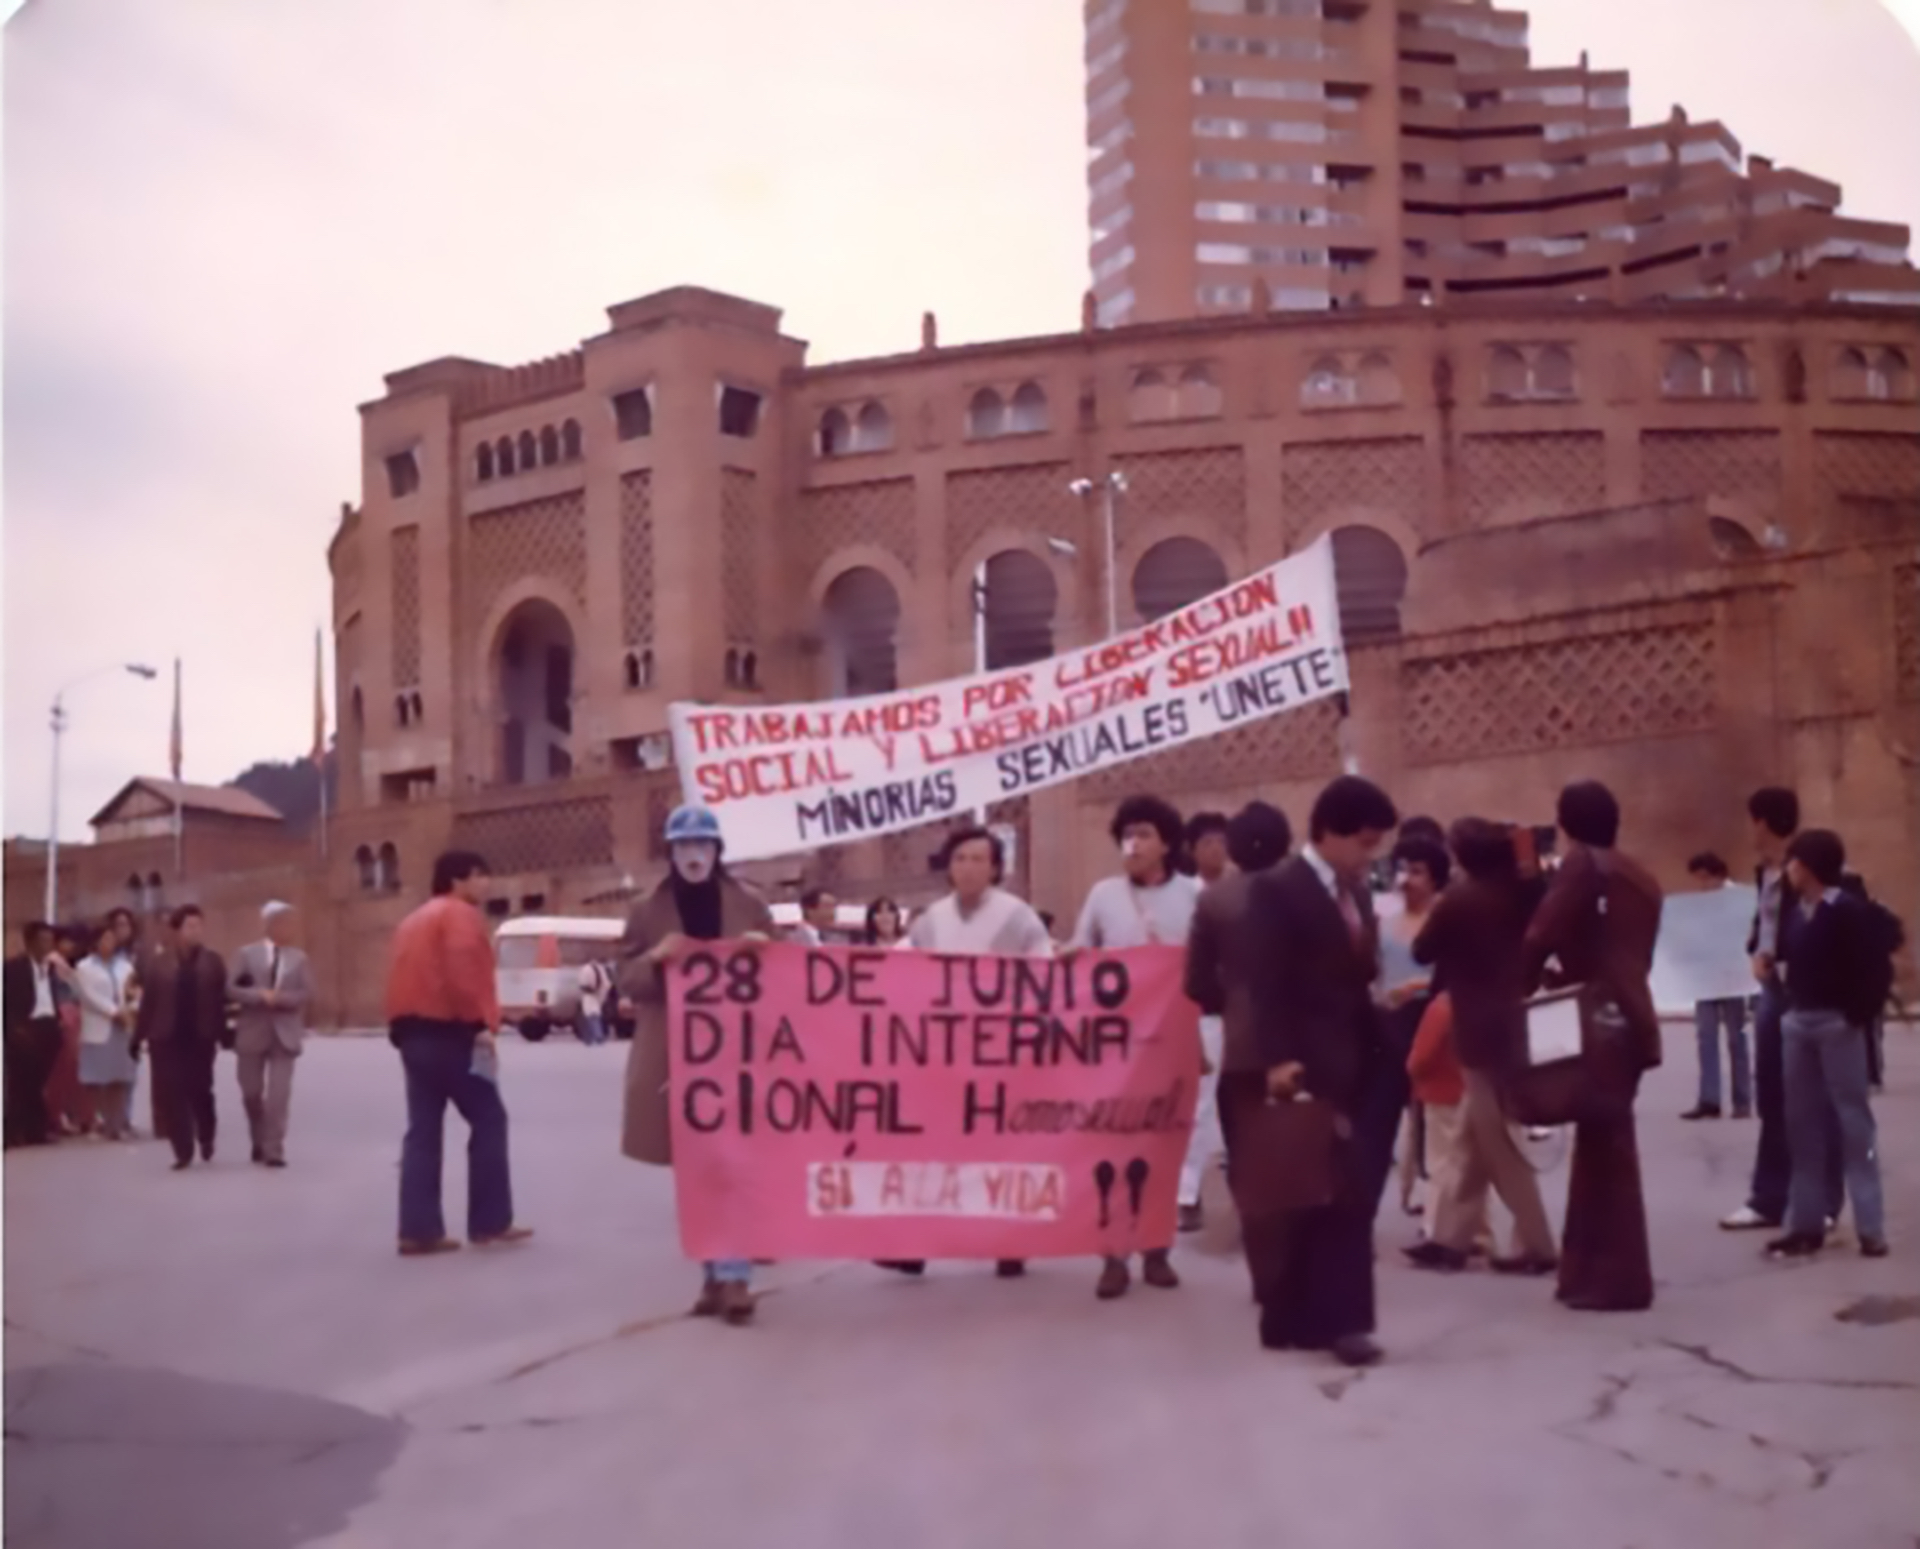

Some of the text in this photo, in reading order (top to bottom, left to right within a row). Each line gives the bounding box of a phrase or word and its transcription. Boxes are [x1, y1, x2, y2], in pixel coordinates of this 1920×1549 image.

[687, 573, 1279, 753] TRABAJAMOS POR LIBERACION
[696, 746, 854, 804] SOCIAL
[873, 732, 895, 771] Y
[998, 700, 1189, 792] SEXUALES
[682, 950, 1131, 1011] 28 DE JUNIO
[683, 1009, 805, 1064] DIA
[683, 1071, 924, 1135] CIONAL
[880, 1163, 905, 1207] A
[983, 1168, 1060, 1214] VIDA
